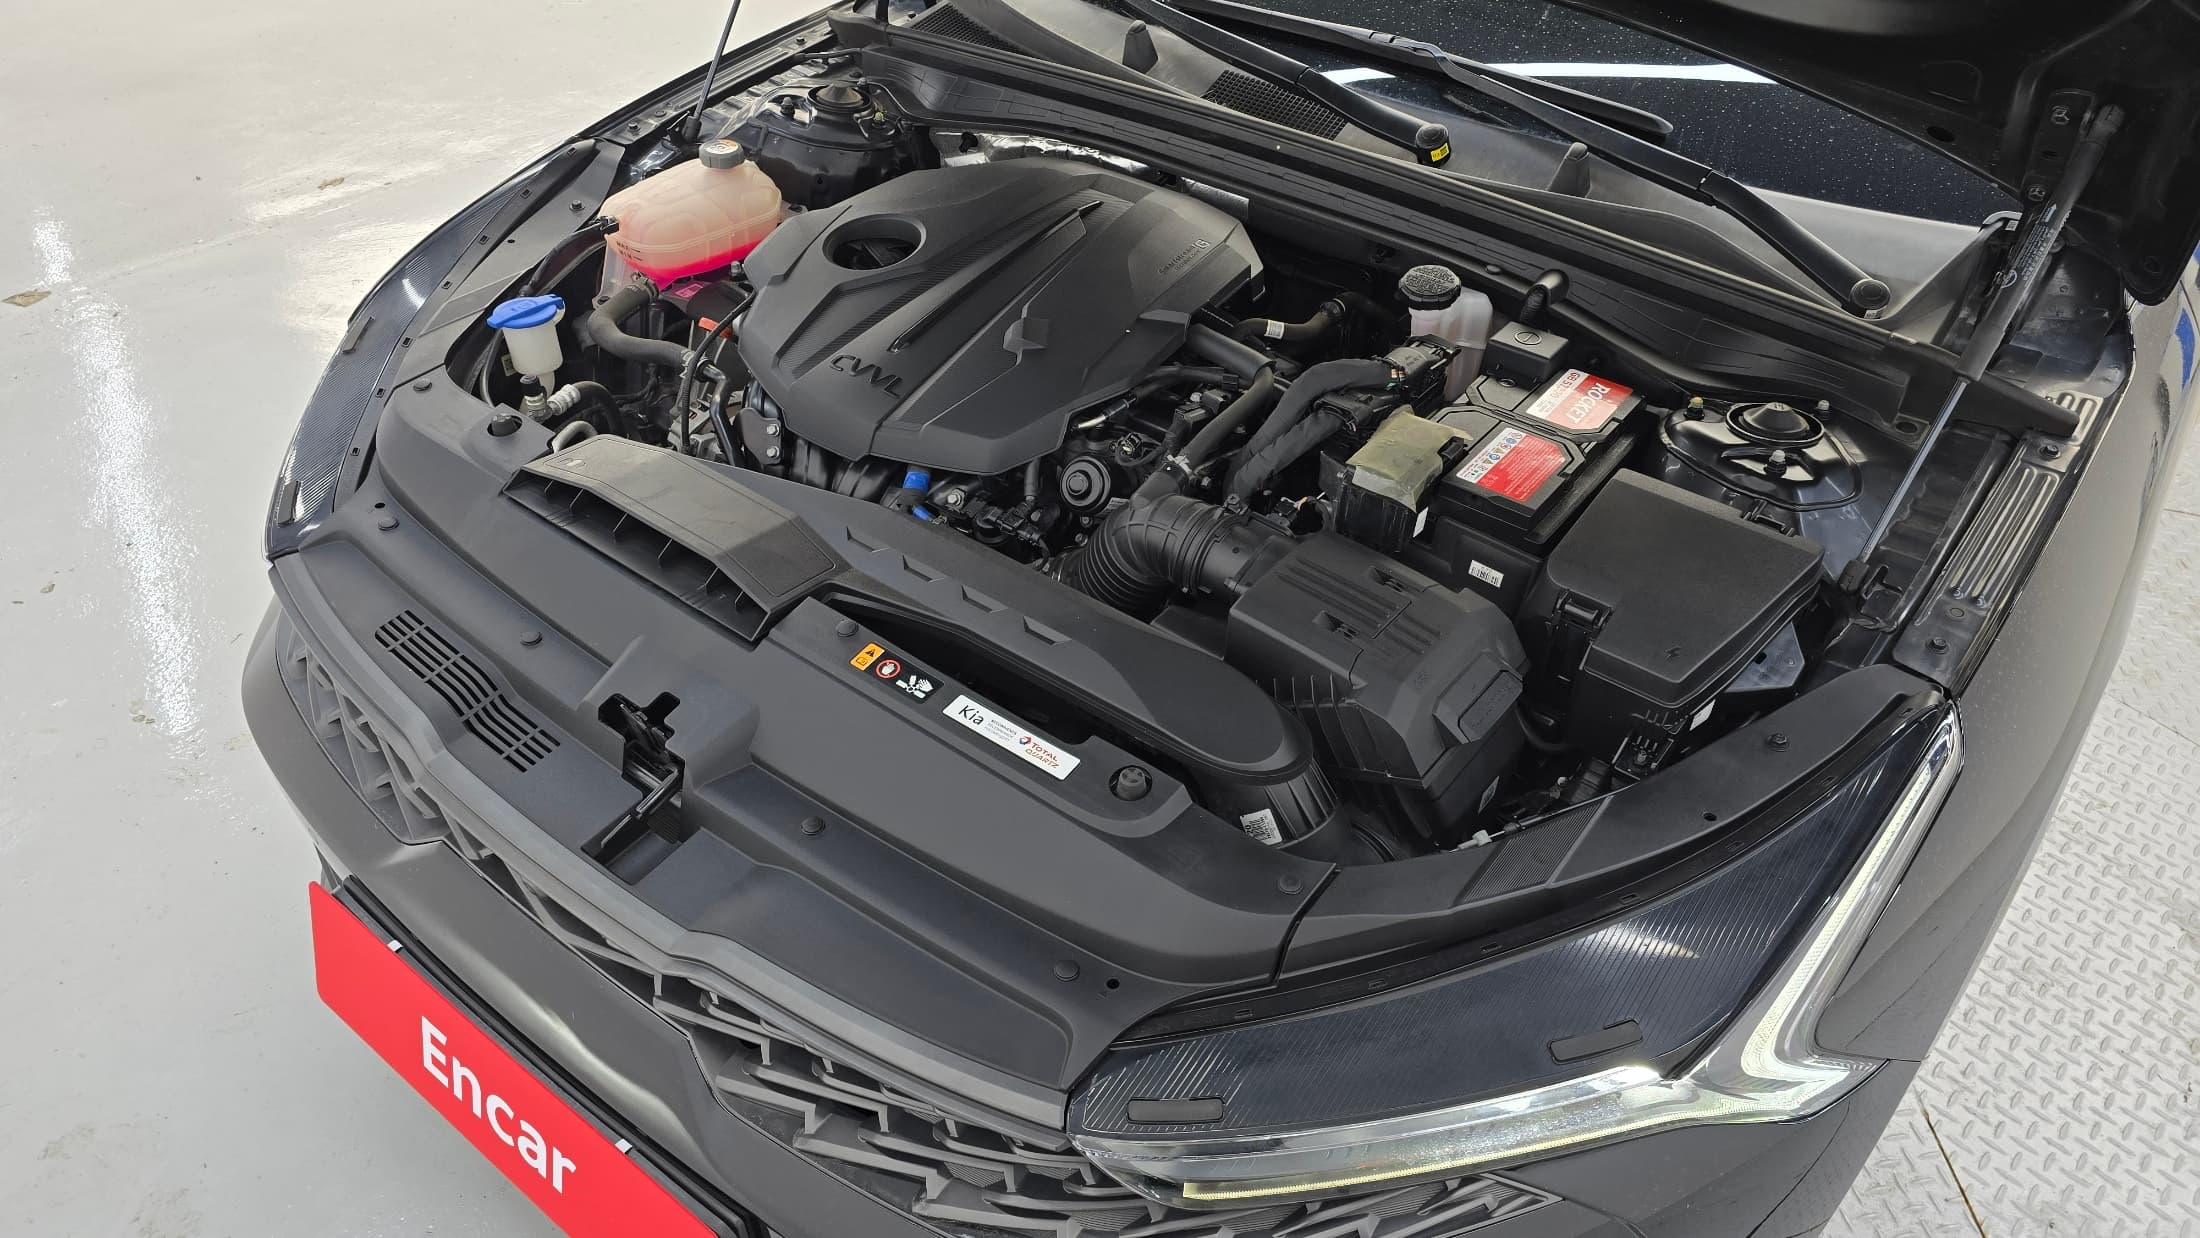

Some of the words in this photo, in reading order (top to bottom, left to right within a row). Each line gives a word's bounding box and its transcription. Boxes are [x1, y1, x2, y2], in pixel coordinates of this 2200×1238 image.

[829, 354, 903, 399] CVVL
[1565, 382, 1611, 424] ROCKET
[958, 704, 985, 726] Kia
[1025, 748, 1060, 769] QUARTZ
[1031, 742, 1059, 762] TOTAL
[421, 1015, 577, 1194] Encar
